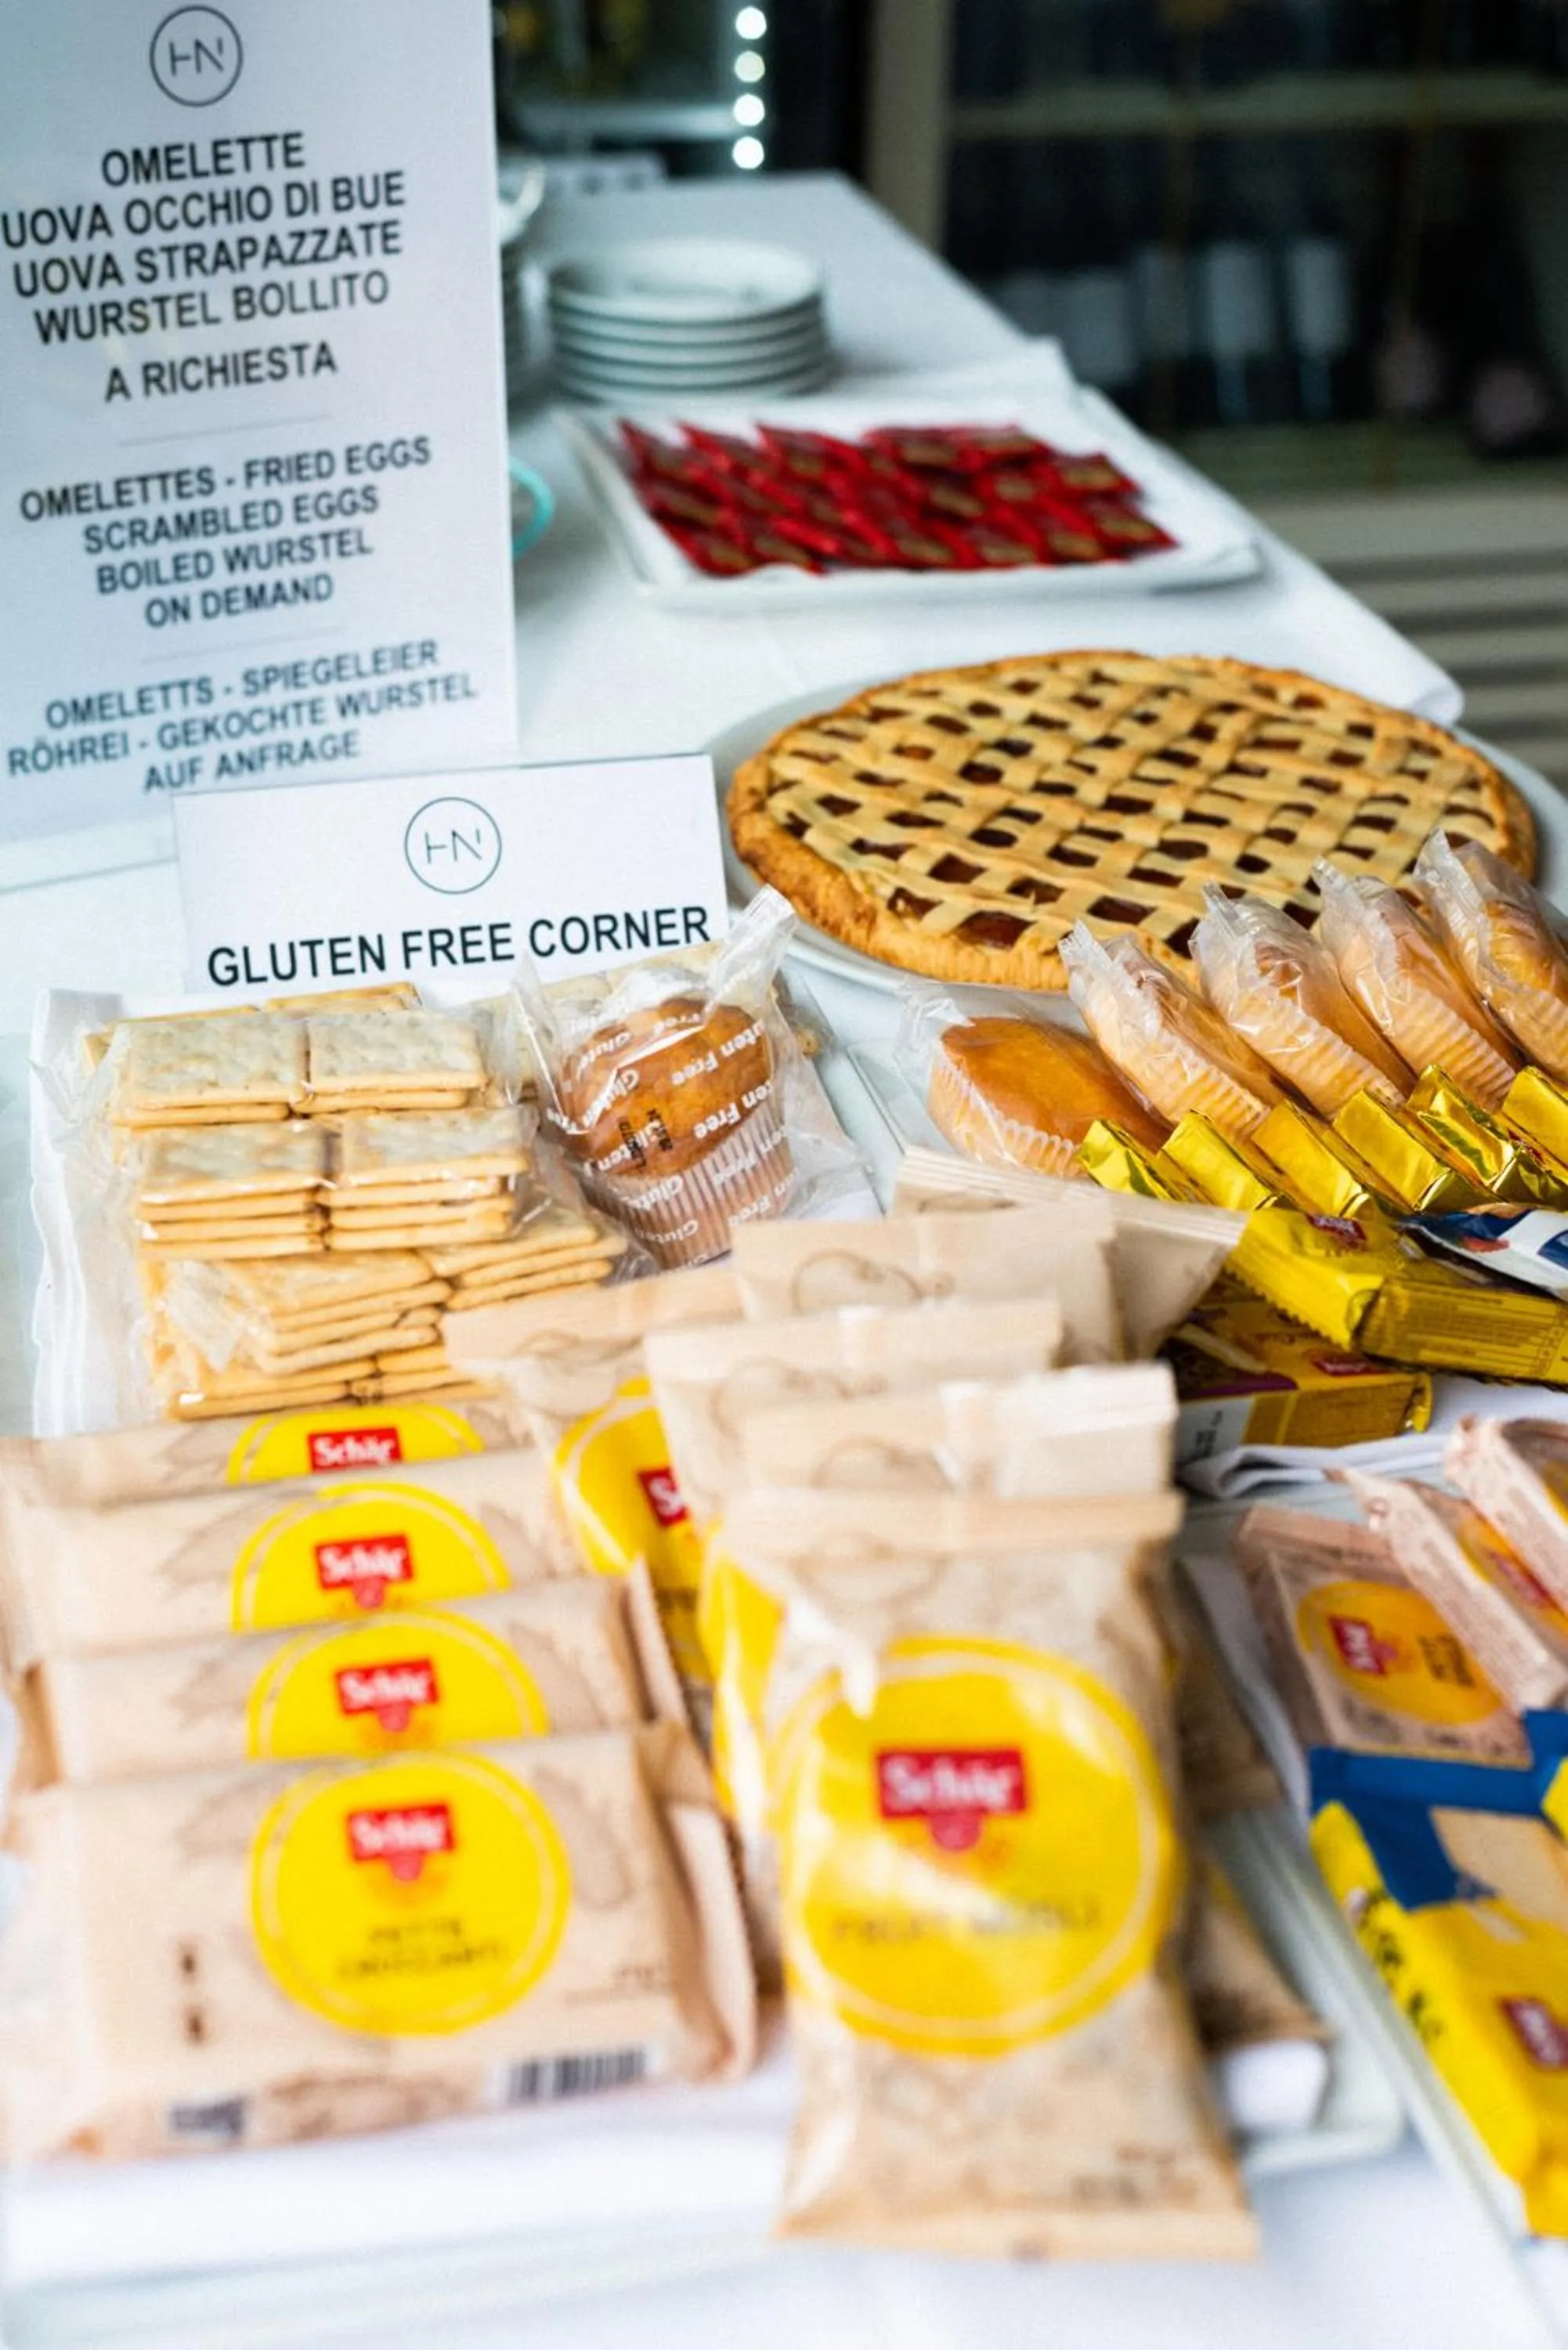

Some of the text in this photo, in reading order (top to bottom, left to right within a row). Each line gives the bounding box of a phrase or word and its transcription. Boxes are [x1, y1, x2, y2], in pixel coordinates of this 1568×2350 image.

[102, 132, 305, 187] OMELETTE
[1, 171, 405, 249] UOVA OCCHIO DI BUE
[13, 219, 401, 298] UOVA STRAPAZZATE
[34, 269, 388, 345] WURSTEL BOLLITO
[105, 342, 337, 402] A RICHIESTA
[20, 466, 215, 522] OMELETTES
[244, 450, 335, 488] FRIED
[345, 436, 431, 475] EGGS
[84, 484, 379, 555] SCRAMBLED EGGS
[96, 528, 371, 595] BOILED WURSTEL
[145, 573, 332, 627] ON DEMAND
[45, 676, 214, 729] OMELETTS
[242, 639, 437, 697] SPIEGELEIER
[7, 732, 129, 776] RÖHREI
[157, 696, 326, 750] GEKOCHTE
[335, 674, 475, 719] WURSTEL
[144, 731, 357, 793] AUF ANFRAGE
[208, 906, 710, 986] GLUTEN FREE CORNER
[671, 1054, 719, 1086] Free
[693, 1102, 742, 1140] Free
